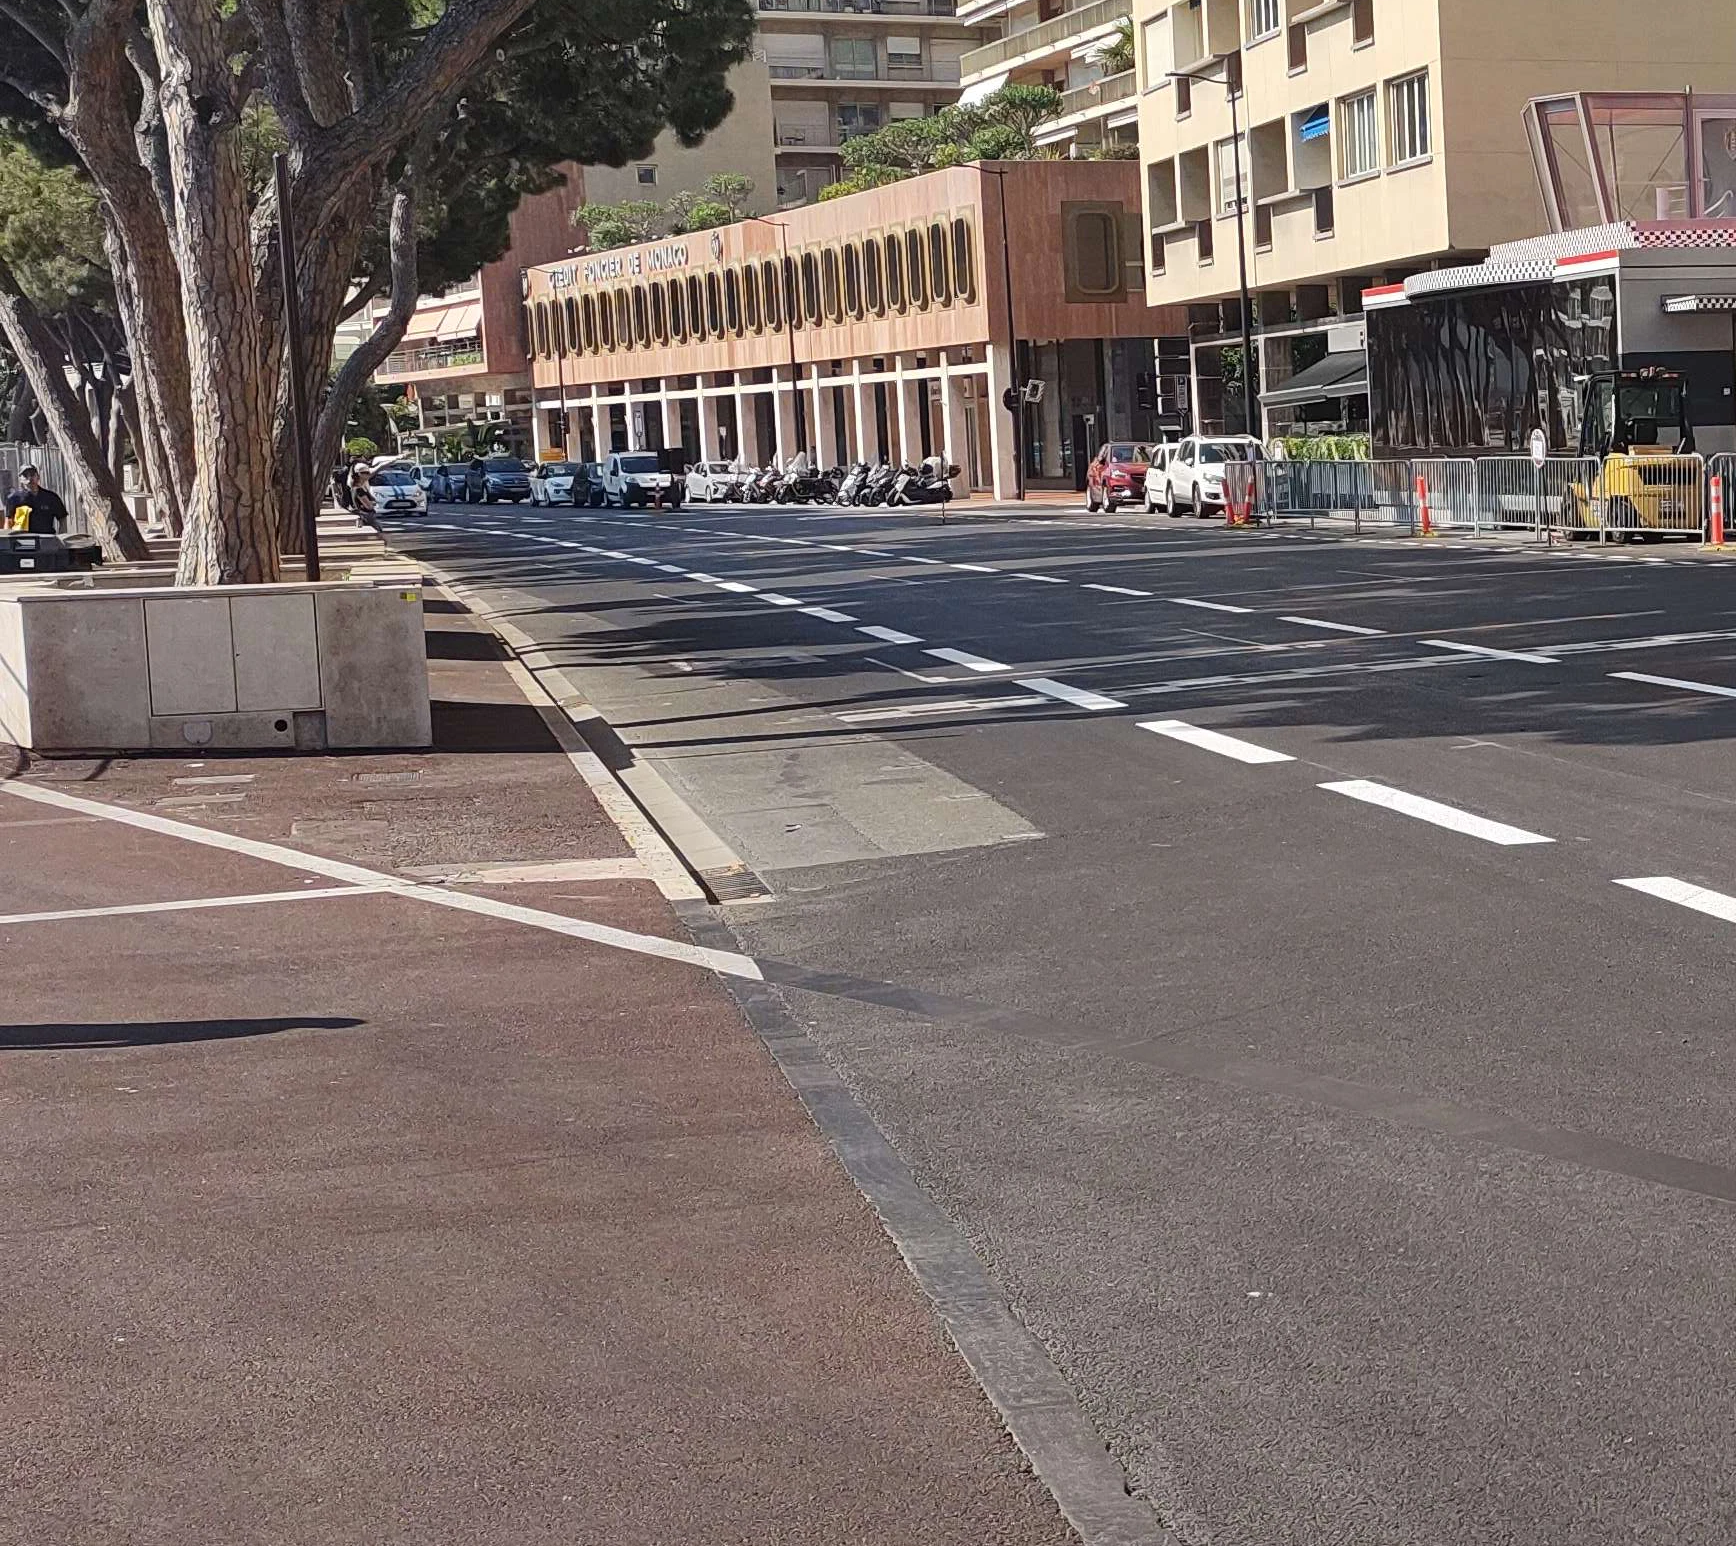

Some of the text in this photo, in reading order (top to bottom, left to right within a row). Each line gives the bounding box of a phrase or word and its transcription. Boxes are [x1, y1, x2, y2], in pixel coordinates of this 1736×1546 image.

[584, 257, 623, 281] FONCIER
[627, 252, 641, 275] DE
[647, 244, 688, 271] MONACO
